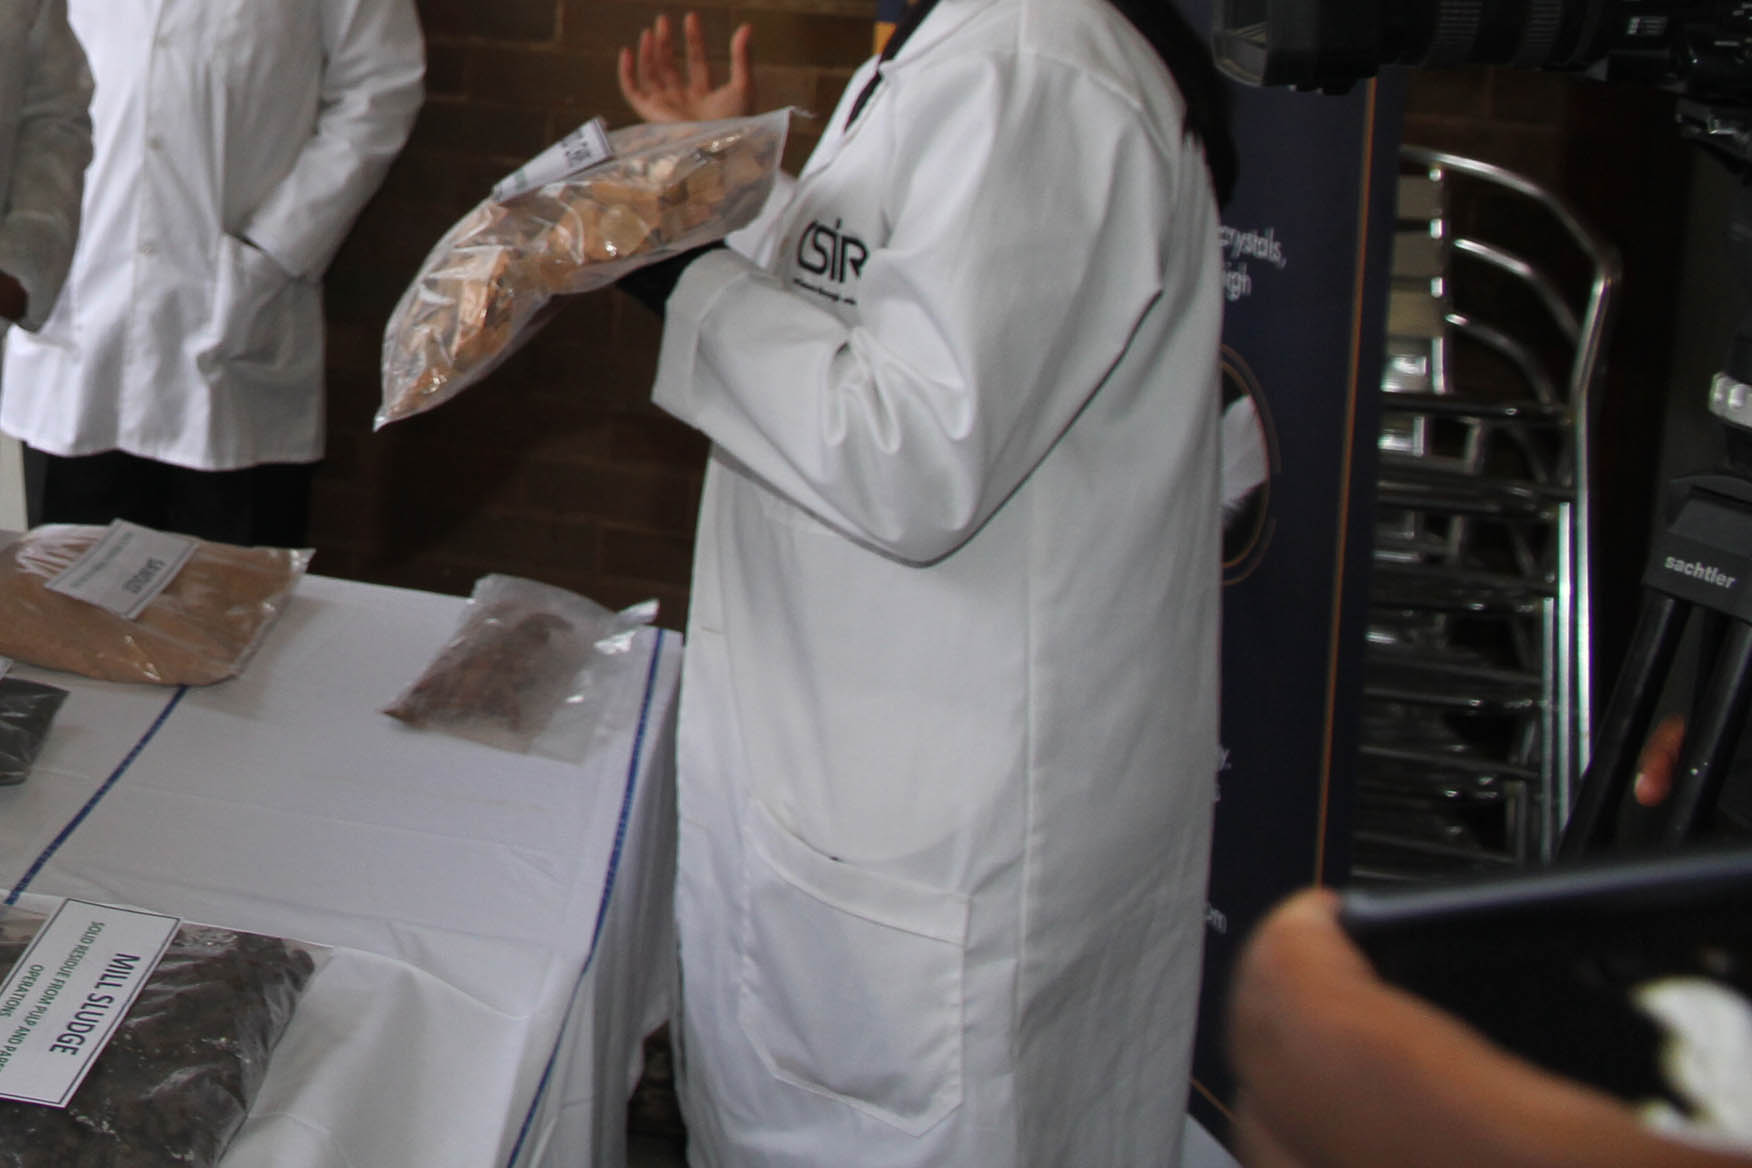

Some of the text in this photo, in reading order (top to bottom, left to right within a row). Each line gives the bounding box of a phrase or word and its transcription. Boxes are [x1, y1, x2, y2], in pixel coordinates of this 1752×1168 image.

[797, 217, 870, 284] CSIR
[1664, 556, 1736, 589] sachtler
[79, 921, 104, 943] SOLID
[56, 945, 88, 976] RESIDUE
[37, 978, 65, 1004] FROM
[49, 952, 140, 1055] MILL SLUDGE
[22, 1006, 45, 1025] PULP
[7, 1026, 30, 1044] AND
